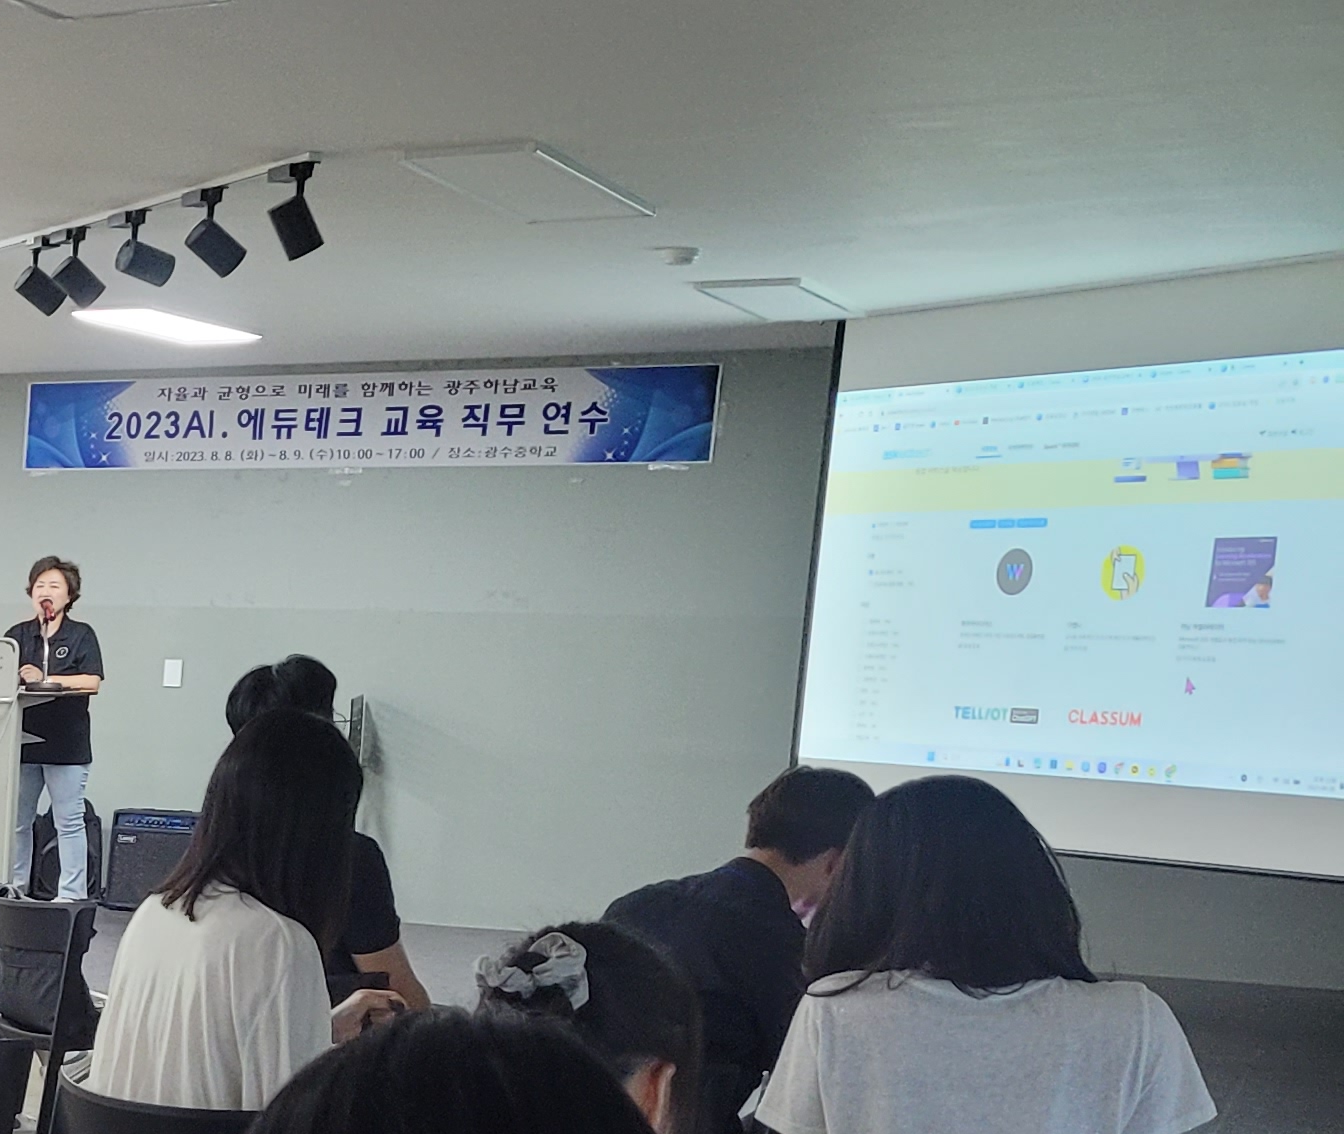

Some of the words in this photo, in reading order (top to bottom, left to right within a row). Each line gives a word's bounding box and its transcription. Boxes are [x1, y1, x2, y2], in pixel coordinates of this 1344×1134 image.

[158, 386, 208, 402] 자율과
[217, 384, 287, 401] 균형으로
[297, 383, 350, 399] 미래를
[361, 380, 433, 398] 함께하는
[443, 377, 559, 396] 광주하남교육
[380, 405, 445, 437] 교육
[461, 403, 526, 437] 직무
[542, 401, 609, 435] 연수
[1067, 708, 1142, 727] CLASSUM
